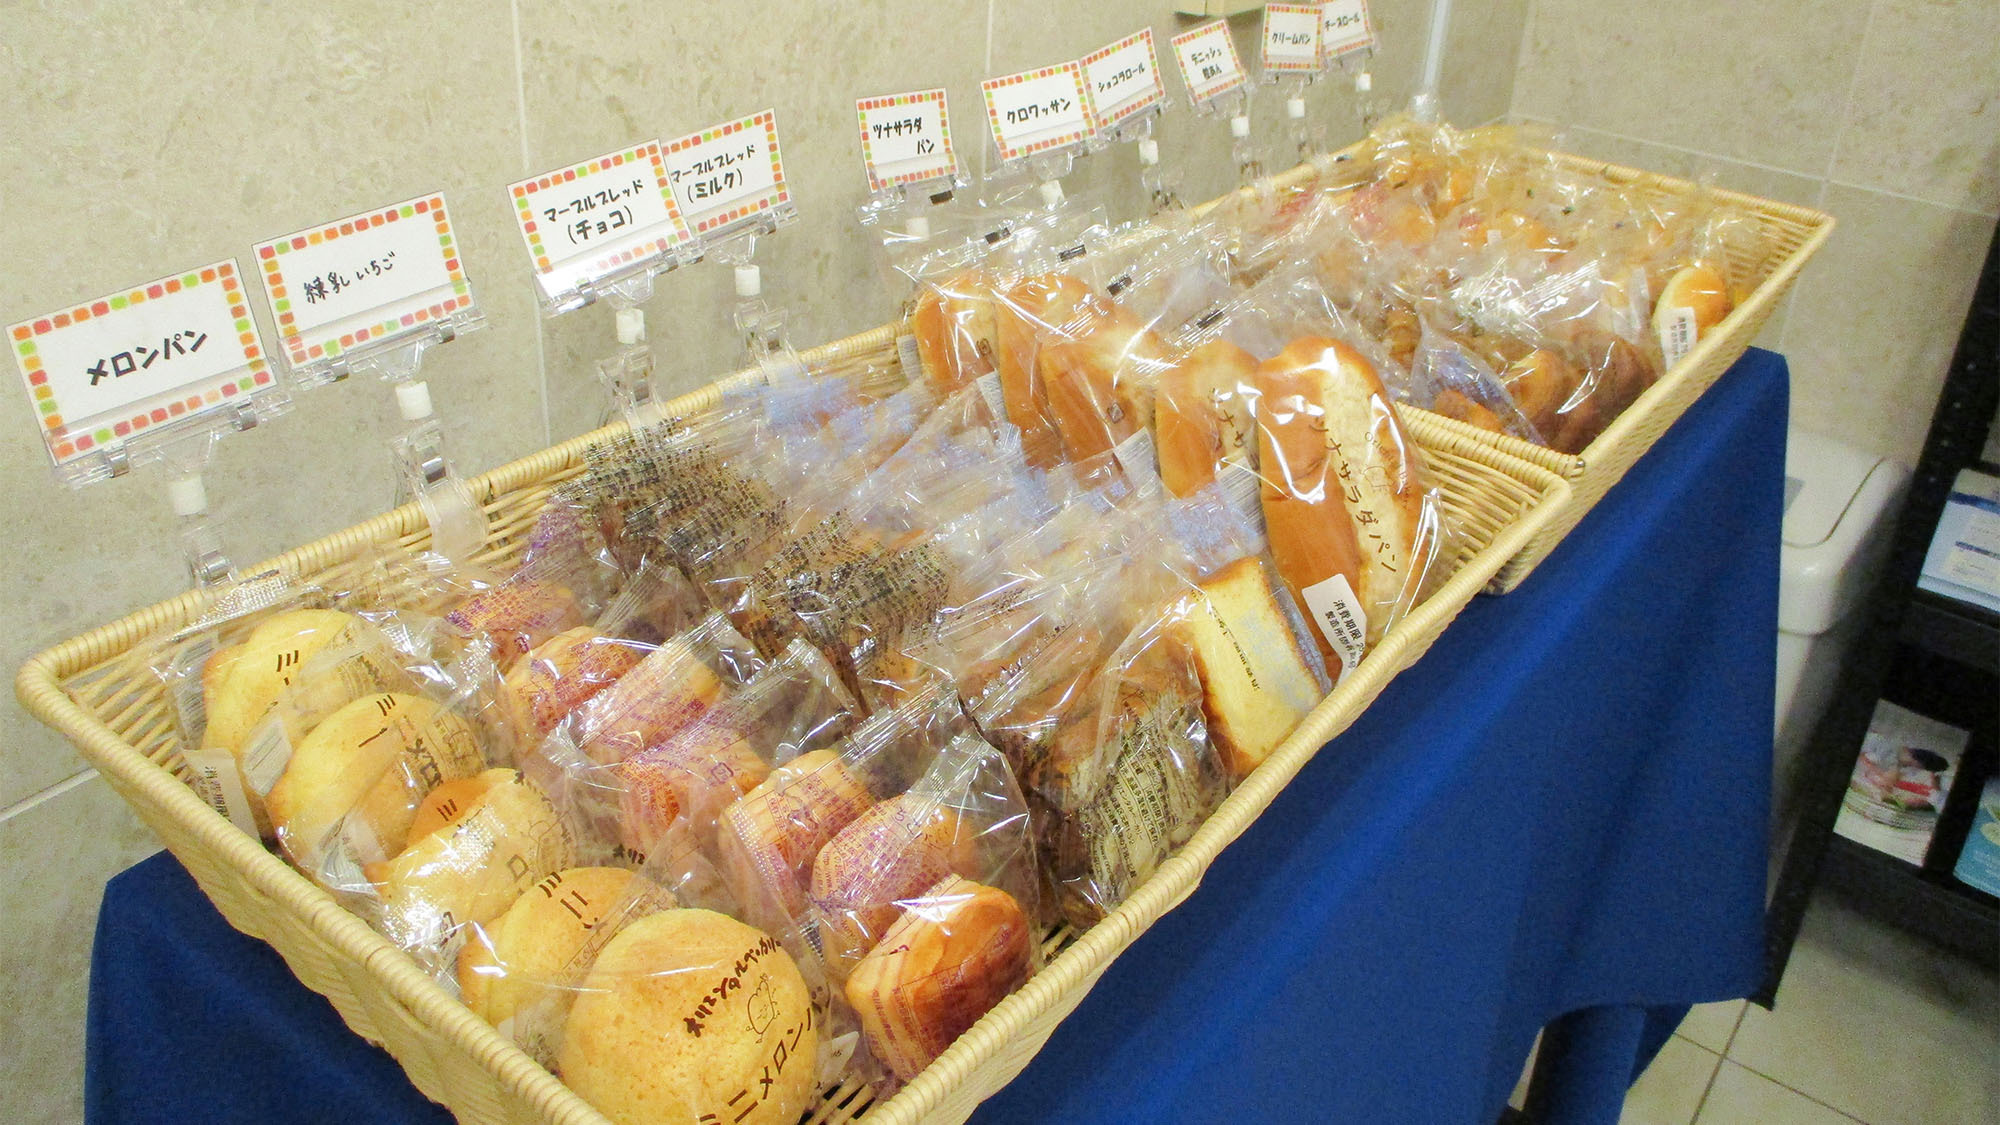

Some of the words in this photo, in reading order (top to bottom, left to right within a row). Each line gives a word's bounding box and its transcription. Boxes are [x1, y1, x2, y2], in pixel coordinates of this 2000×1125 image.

[1098, 62, 1146, 92] ショコラロール
[872, 116, 923, 141] ツナサラダ
[1006, 98, 1072, 125] クロワッサン
[916, 139, 935, 156] パン
[544, 179, 644, 222] マーブルブレッド
[687, 168, 744, 203] (ミルク)
[567, 205, 634, 245] (チョコ)
[87, 330, 207, 386] メロンパン
[1309, 415, 1397, 573] ツナサラダパン
[1333, 599, 1363, 641] 消費期限
